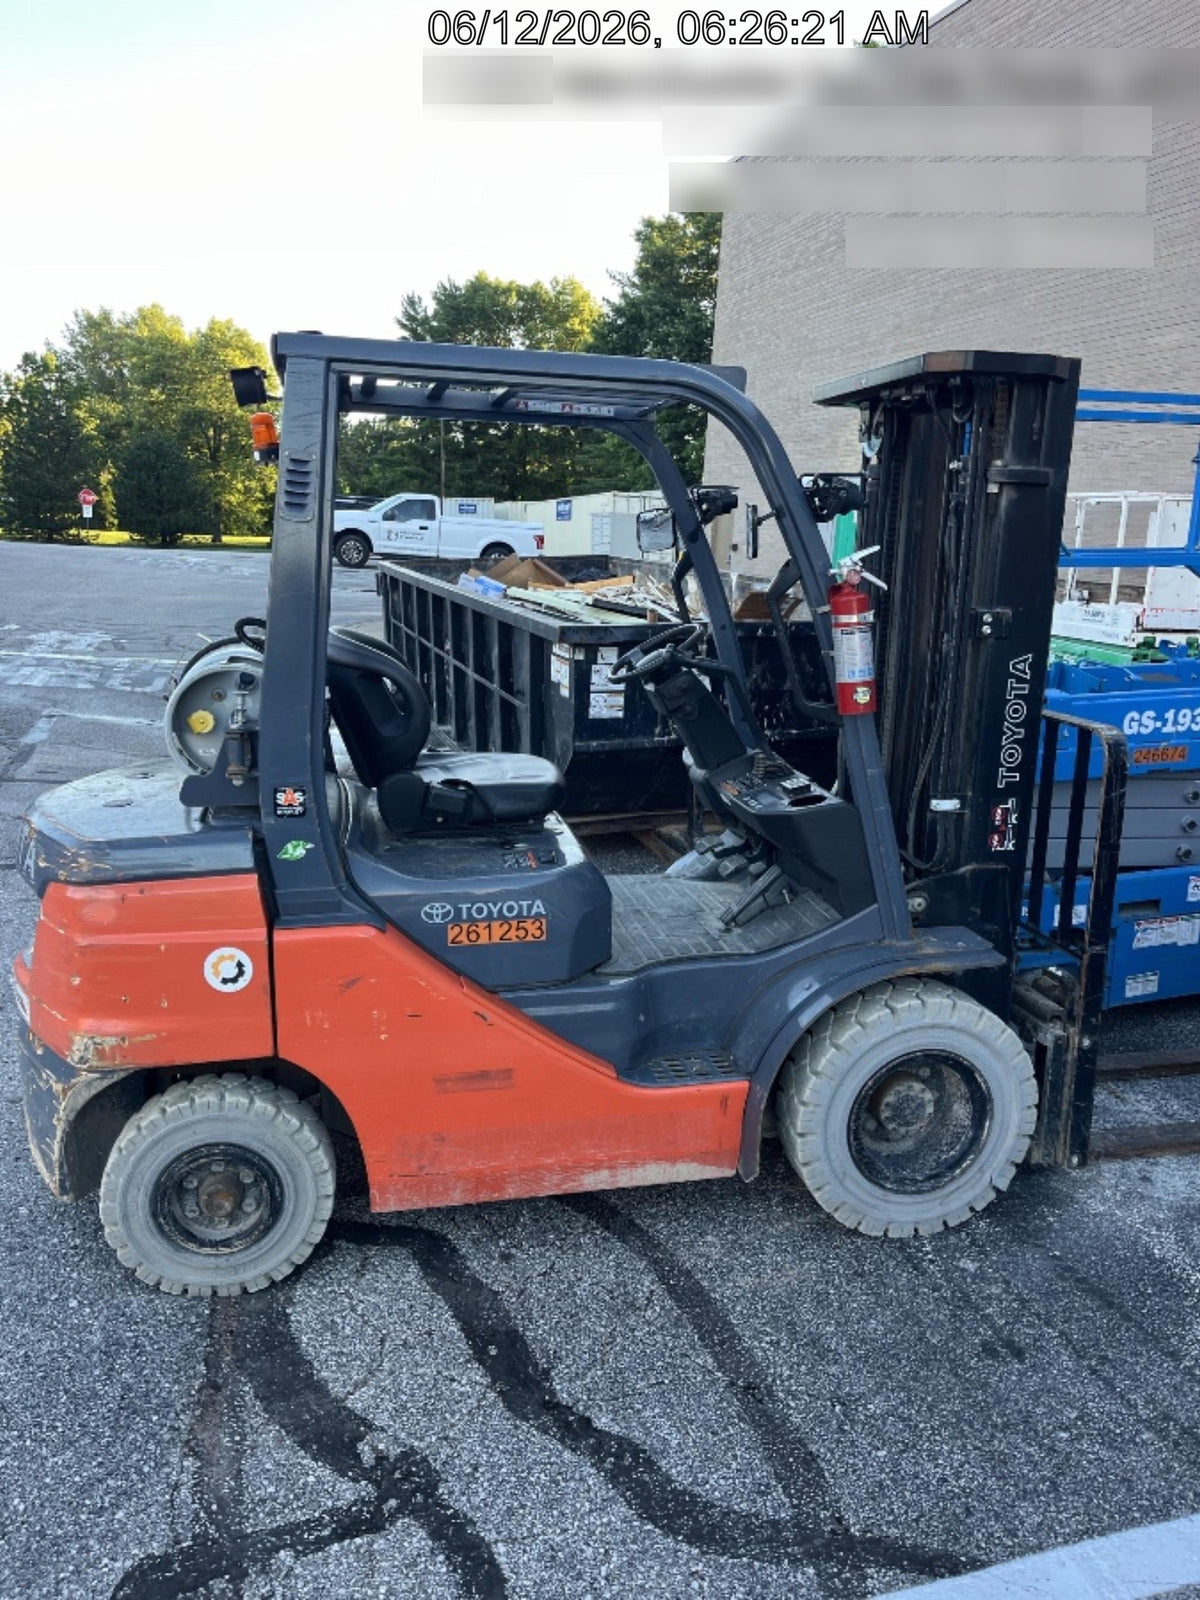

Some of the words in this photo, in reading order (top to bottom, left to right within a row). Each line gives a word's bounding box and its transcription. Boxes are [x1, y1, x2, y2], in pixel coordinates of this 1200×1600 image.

[997, 653, 1033, 788] TOYOTA
[458, 899, 547, 920] TOYOTA
[449, 919, 546, 944] 261253
